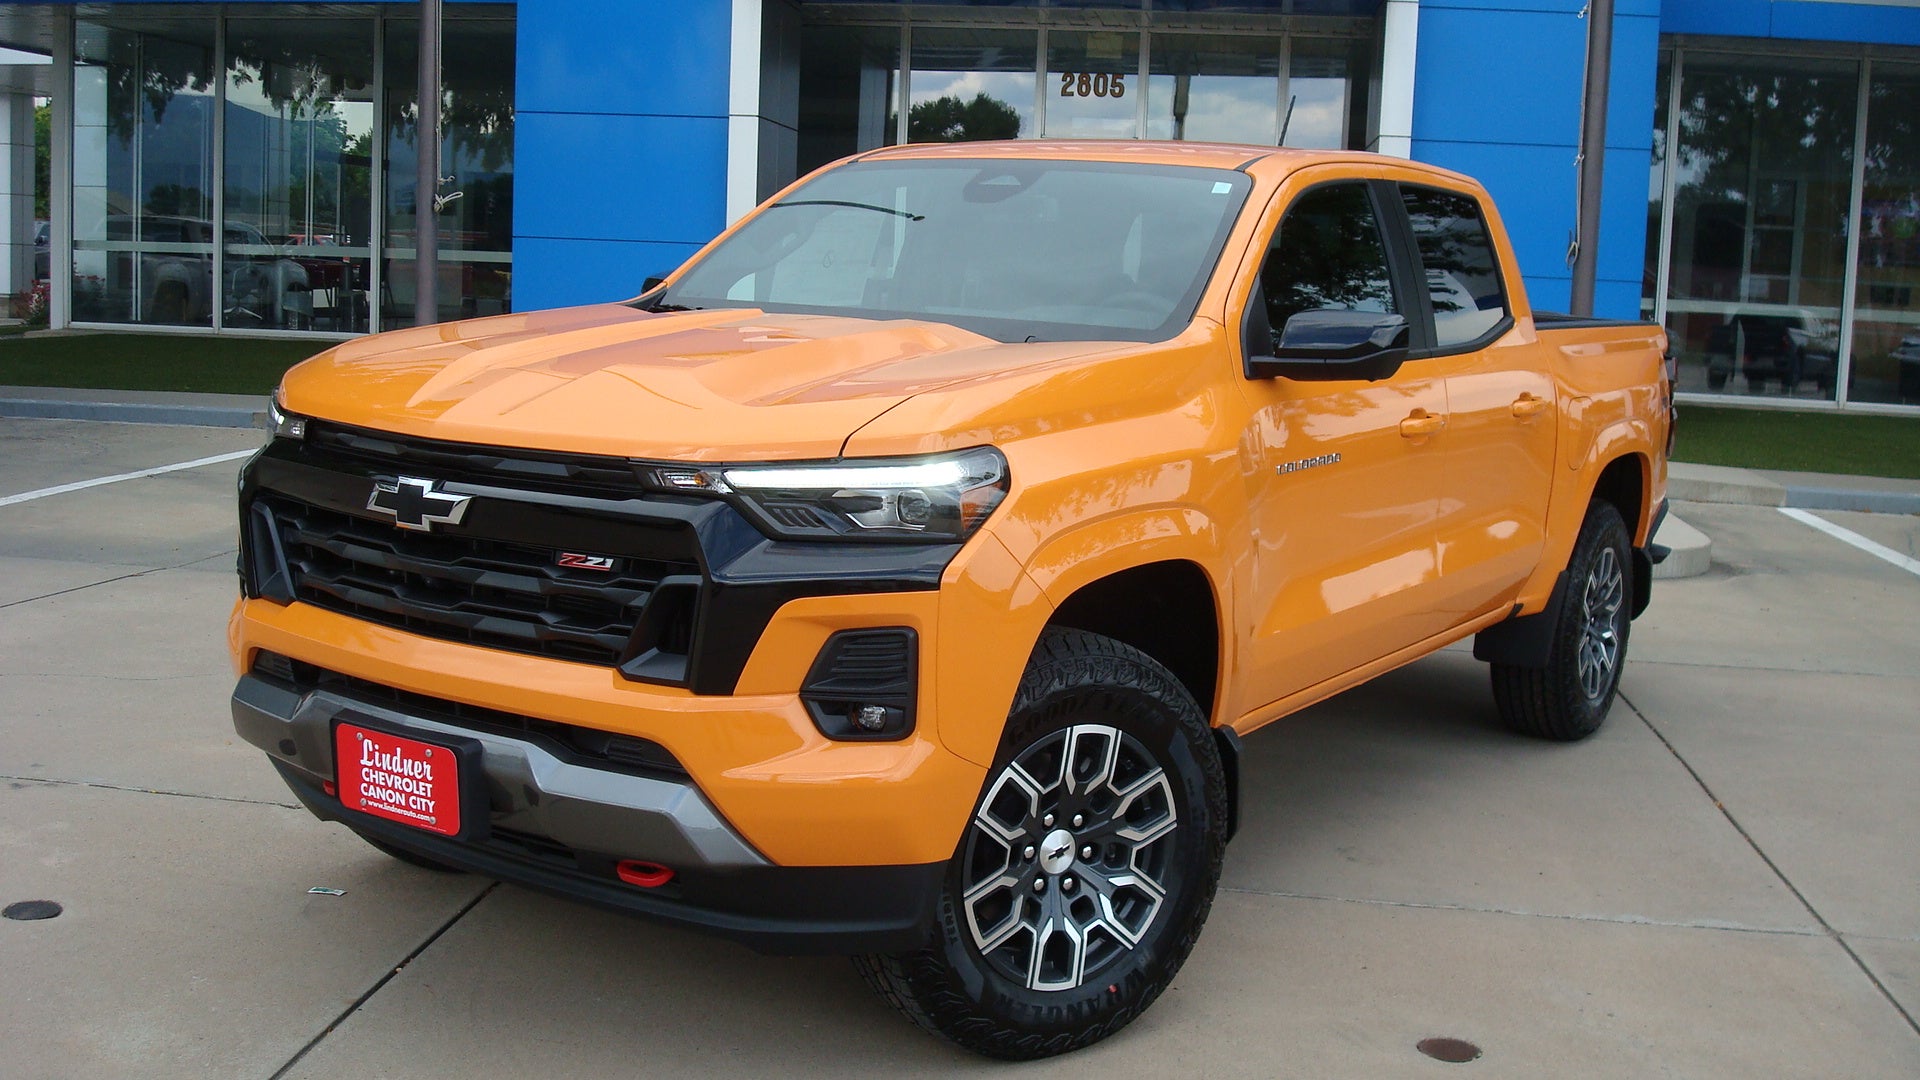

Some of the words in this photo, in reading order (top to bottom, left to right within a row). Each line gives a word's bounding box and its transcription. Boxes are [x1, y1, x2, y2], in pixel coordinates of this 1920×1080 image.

[1061, 71, 1125, 98] 2805
[558, 552, 614, 571] Z71
[360, 738, 434, 781] Lindner
[360, 782, 406, 807] CANON
[408, 795, 436, 814] CITY
[361, 767, 433, 798] CHEVROLET
